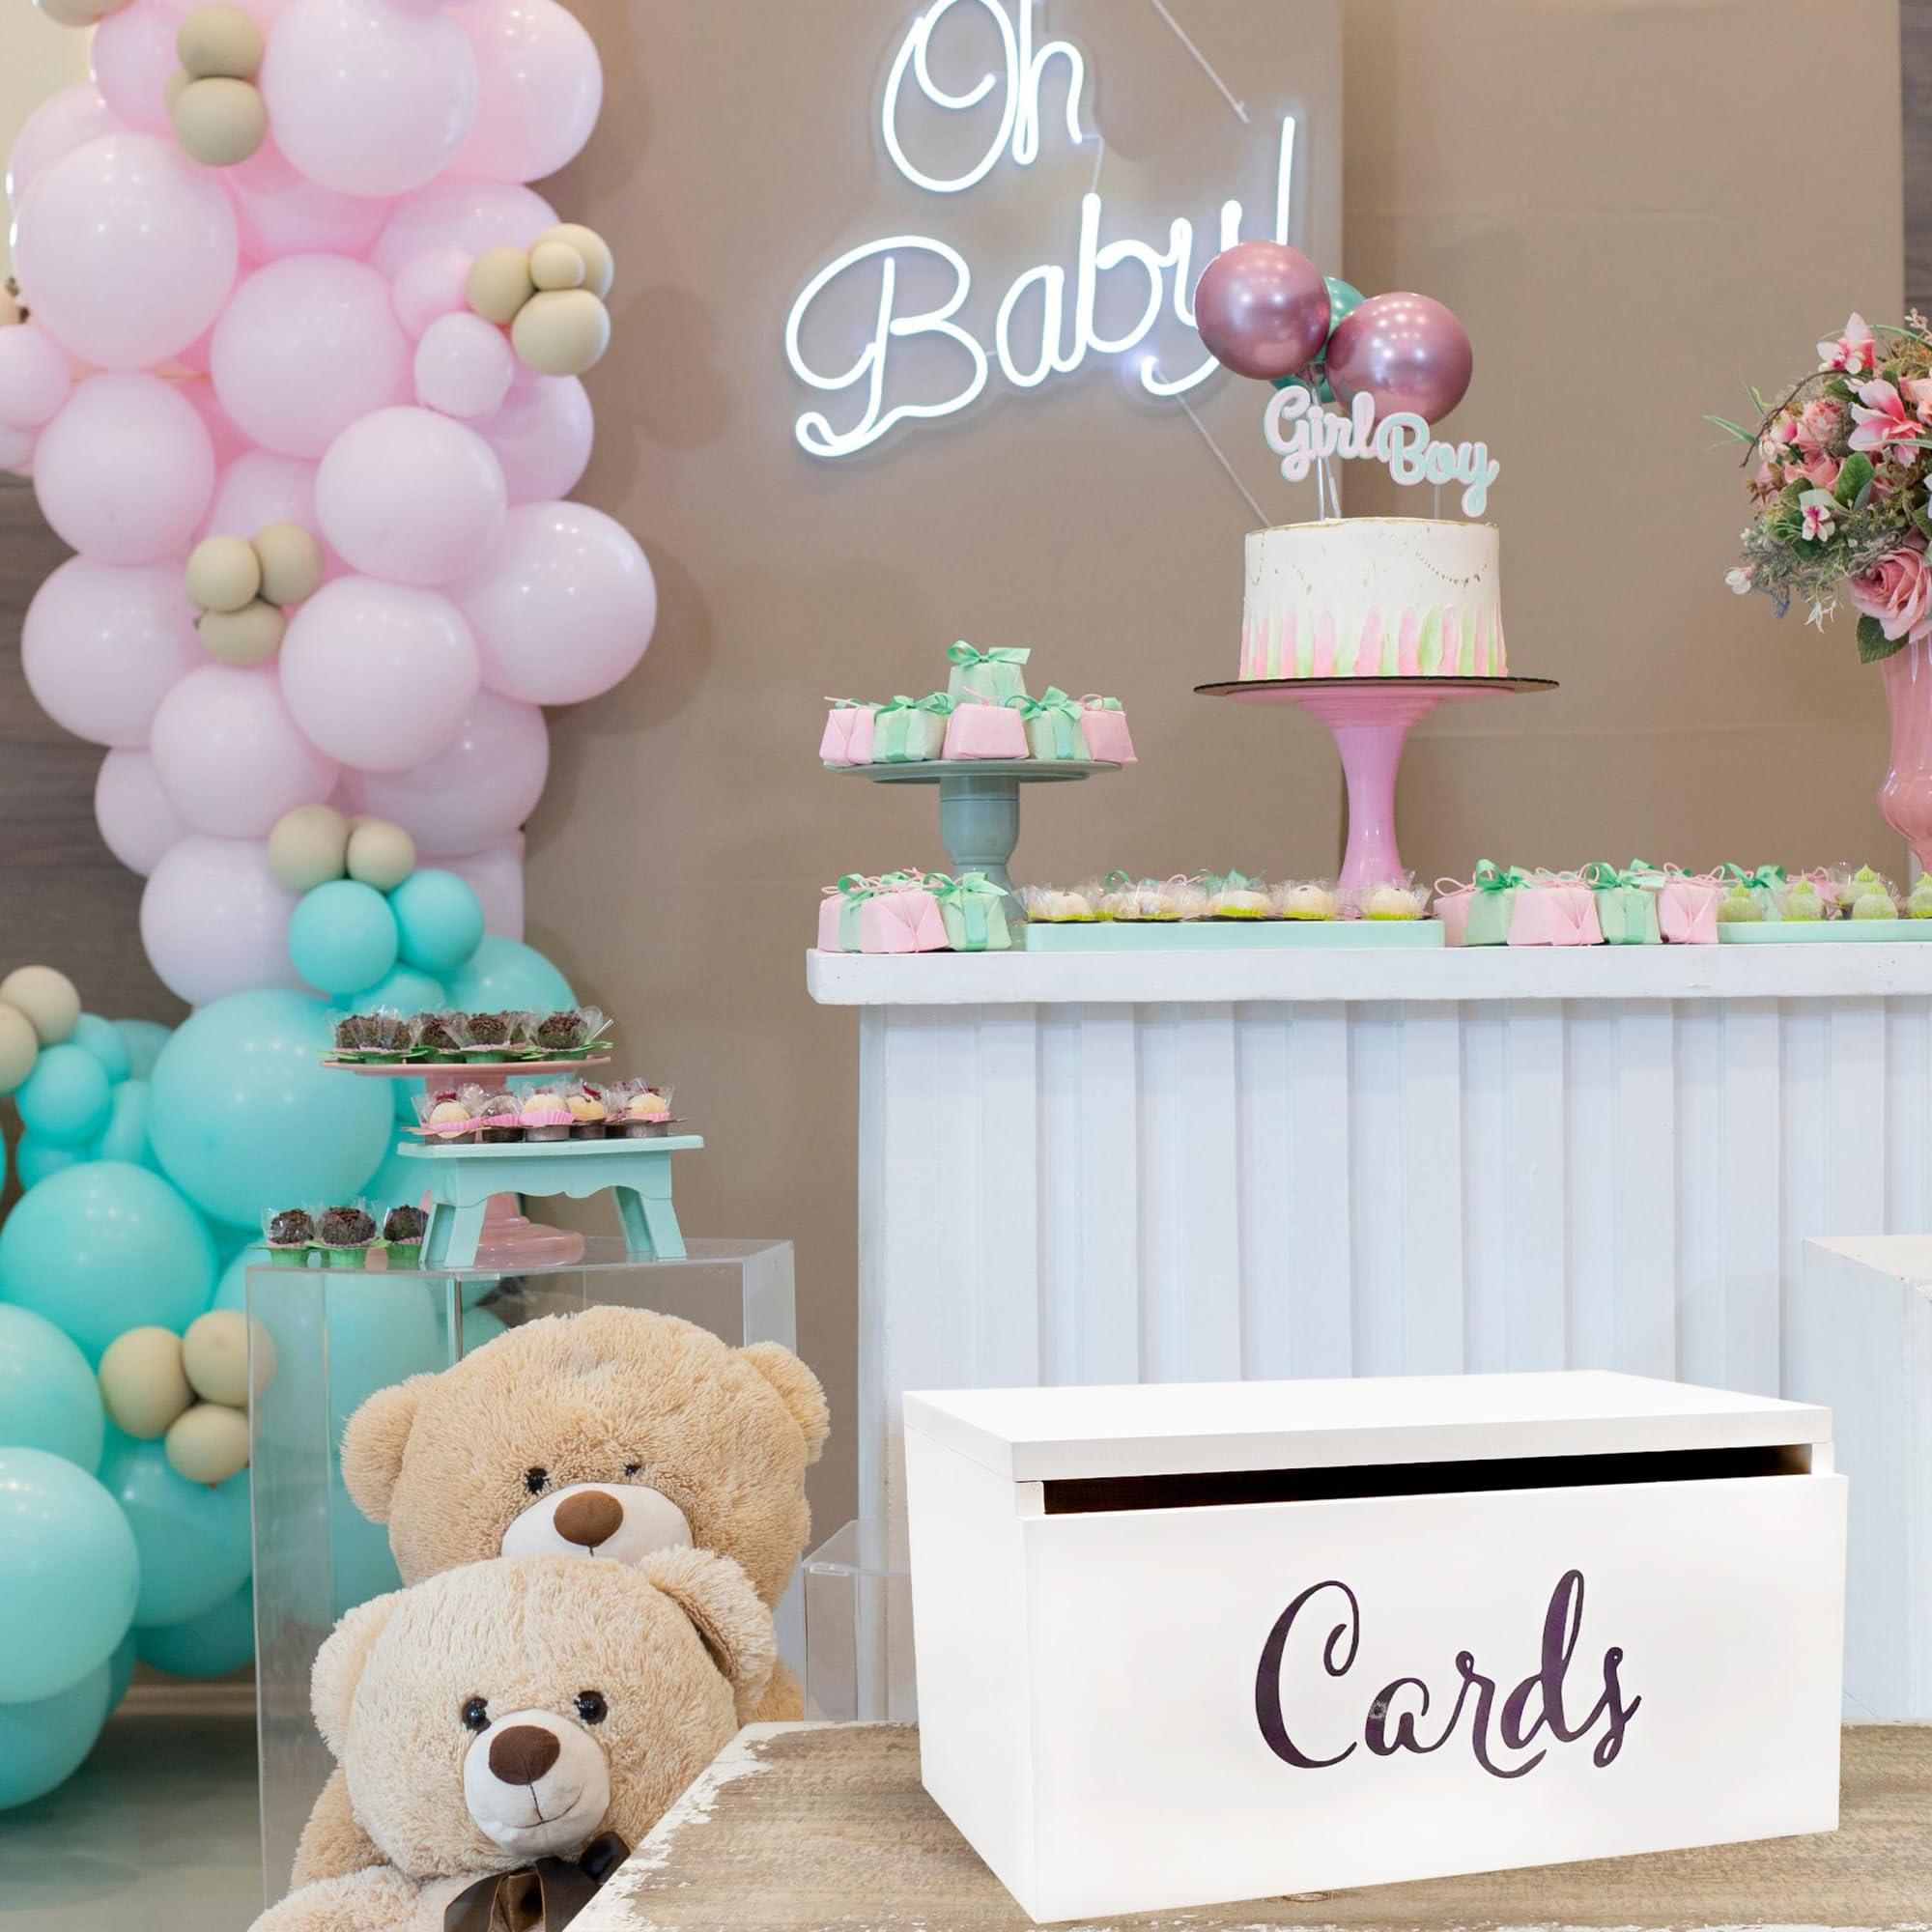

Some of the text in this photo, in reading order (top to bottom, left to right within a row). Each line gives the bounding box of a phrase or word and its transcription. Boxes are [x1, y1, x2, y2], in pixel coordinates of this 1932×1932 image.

[881, 0, 1085, 193] Oh
[1264, 385, 1500, 518] Girl Boy
[1256, 1569, 1642, 1778] Cards
